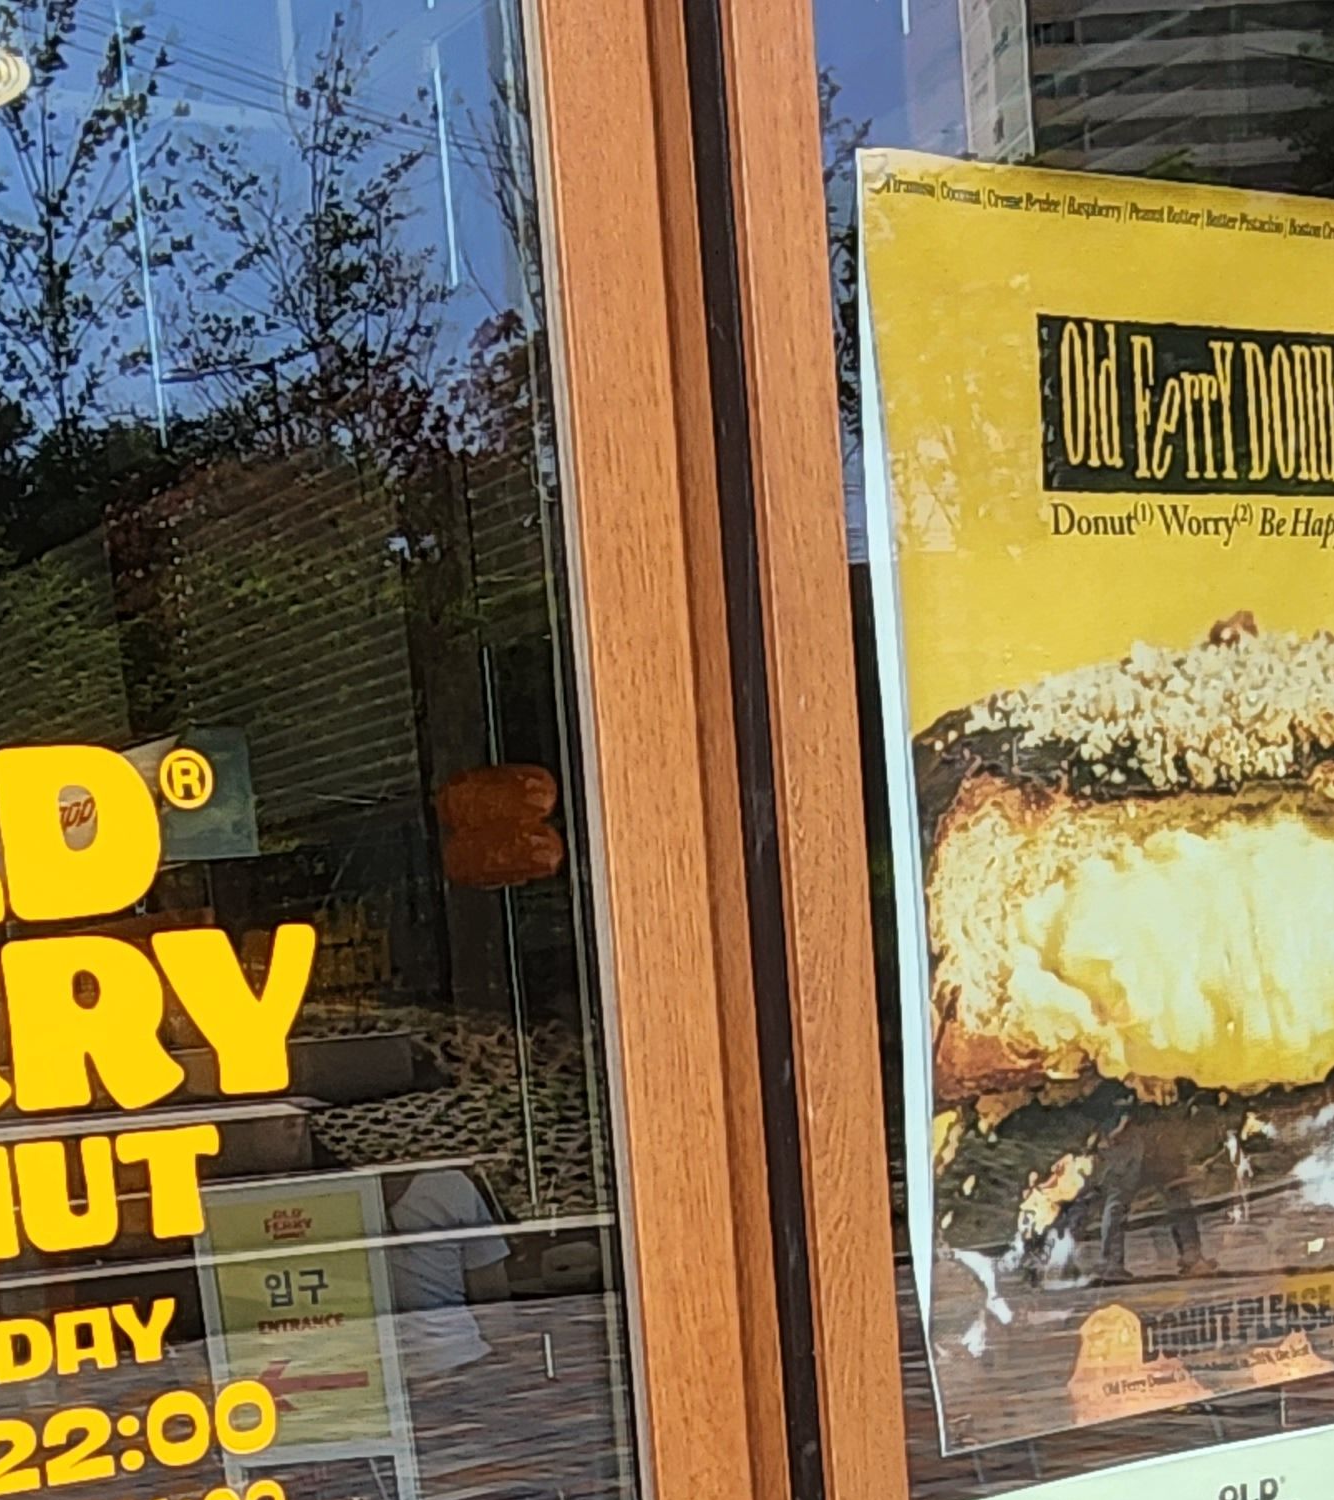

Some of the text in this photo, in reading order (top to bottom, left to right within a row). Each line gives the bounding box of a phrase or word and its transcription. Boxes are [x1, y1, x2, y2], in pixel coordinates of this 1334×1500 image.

[1060, 321, 1124, 469] Old
[1259, 507, 1286, 537] Be
[264, 1269, 329, 1308] 입구
[257, 1313, 344, 1334] ENTRANCE
